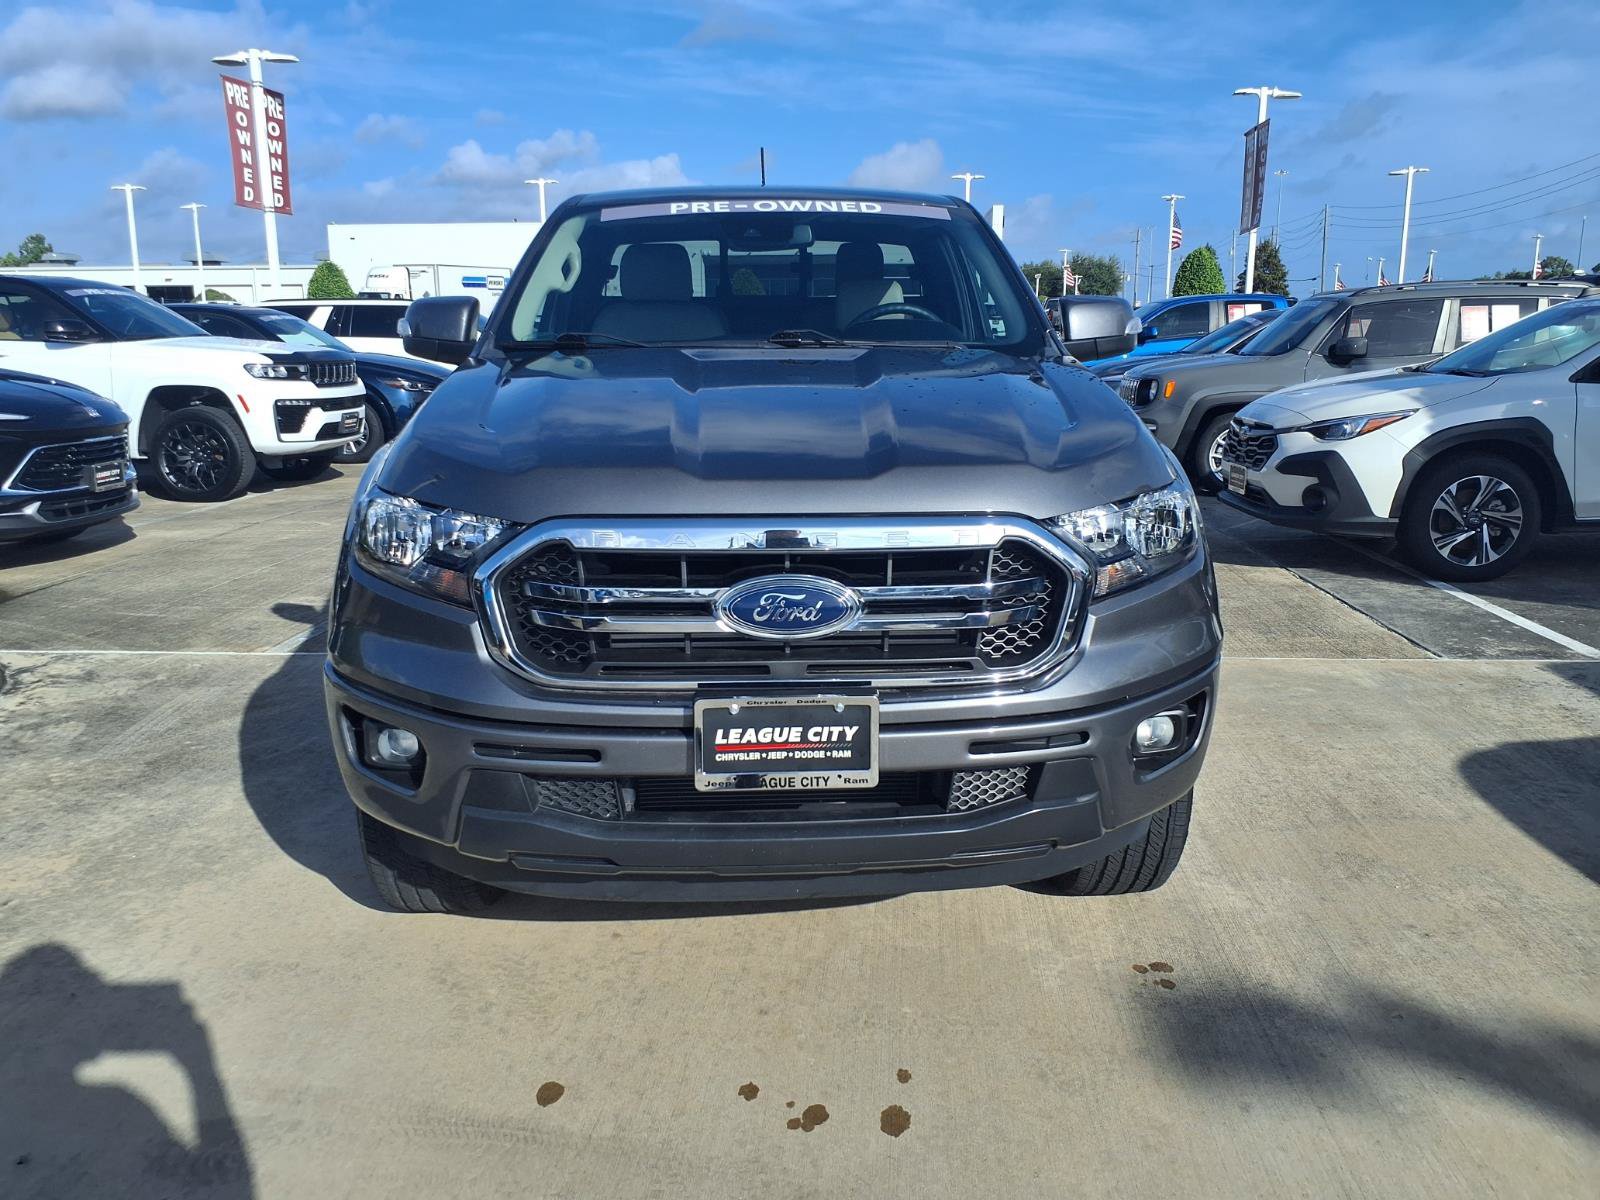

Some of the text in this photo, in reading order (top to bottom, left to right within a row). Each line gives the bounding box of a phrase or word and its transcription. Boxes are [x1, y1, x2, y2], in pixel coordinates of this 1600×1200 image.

[225, 81, 250, 109] PRE
[235, 111, 254, 202] OWNED
[267, 121, 285, 207] OWNED
[669, 199, 882, 215] PRE-OWNED
[752, 592, 824, 622] Ford
[714, 725, 860, 745] LEAGUE CITY
[715, 750, 852, 762] CHRYSLER JEEP DODGE RAM
[800, 775, 830, 788] CITY
[843, 777, 869, 785] Ram
